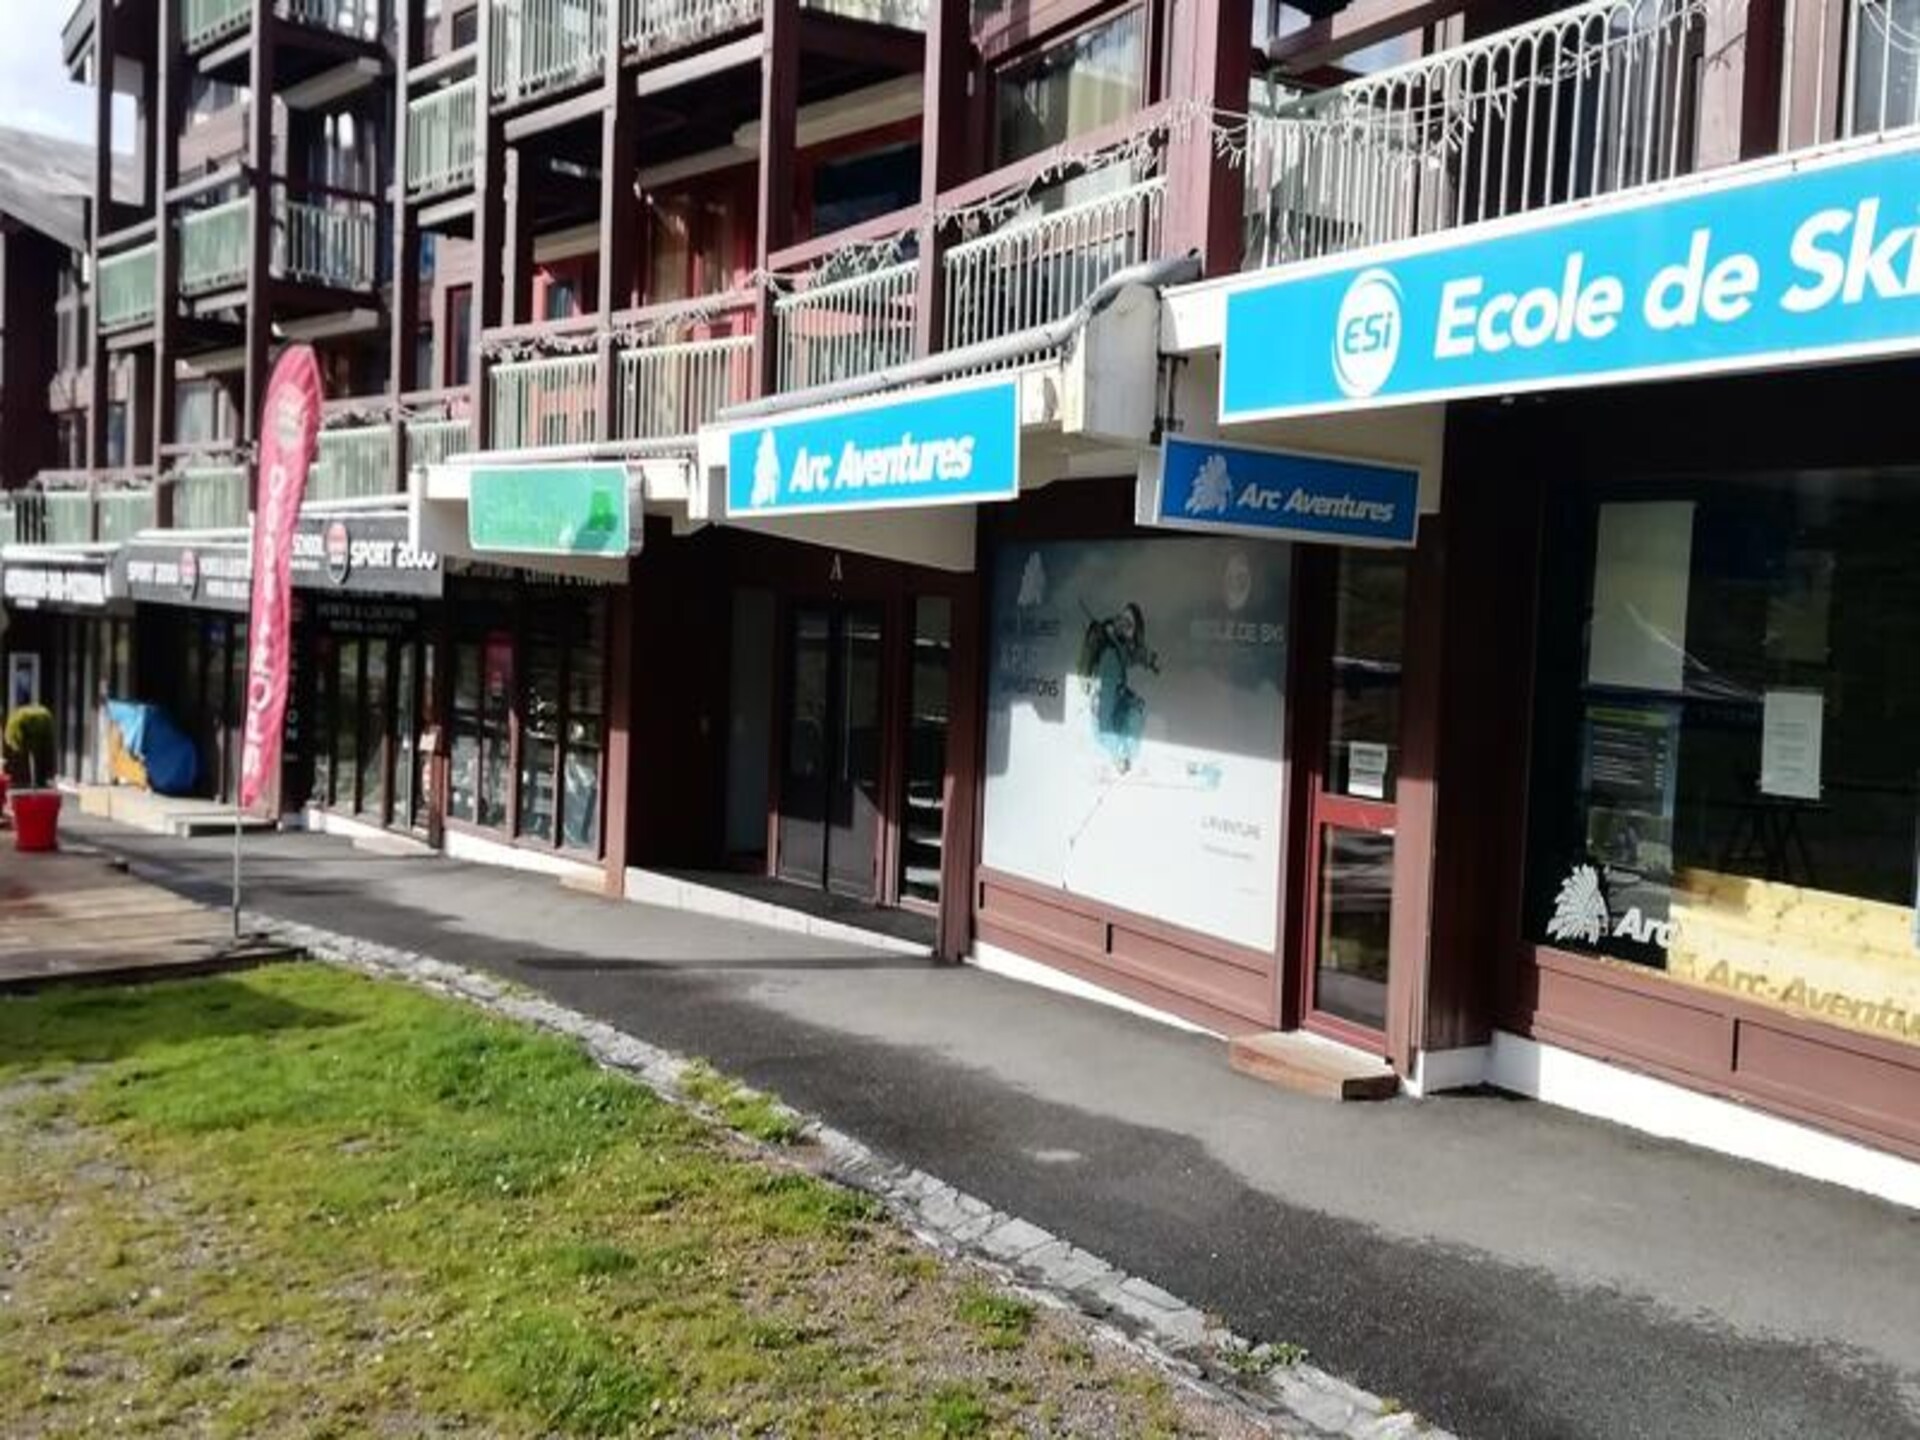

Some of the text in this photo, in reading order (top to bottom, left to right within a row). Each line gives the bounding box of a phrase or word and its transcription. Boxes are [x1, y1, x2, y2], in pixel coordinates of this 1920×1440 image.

[1434, 251, 1624, 359] Ecole
[1643, 228, 1760, 329] de
[788, 431, 976, 493] Arc Aventures
[1237, 482, 1397, 522] Arc Aventures
[350, 541, 395, 568] SPORT
[1613, 906, 1673, 948] Arc
